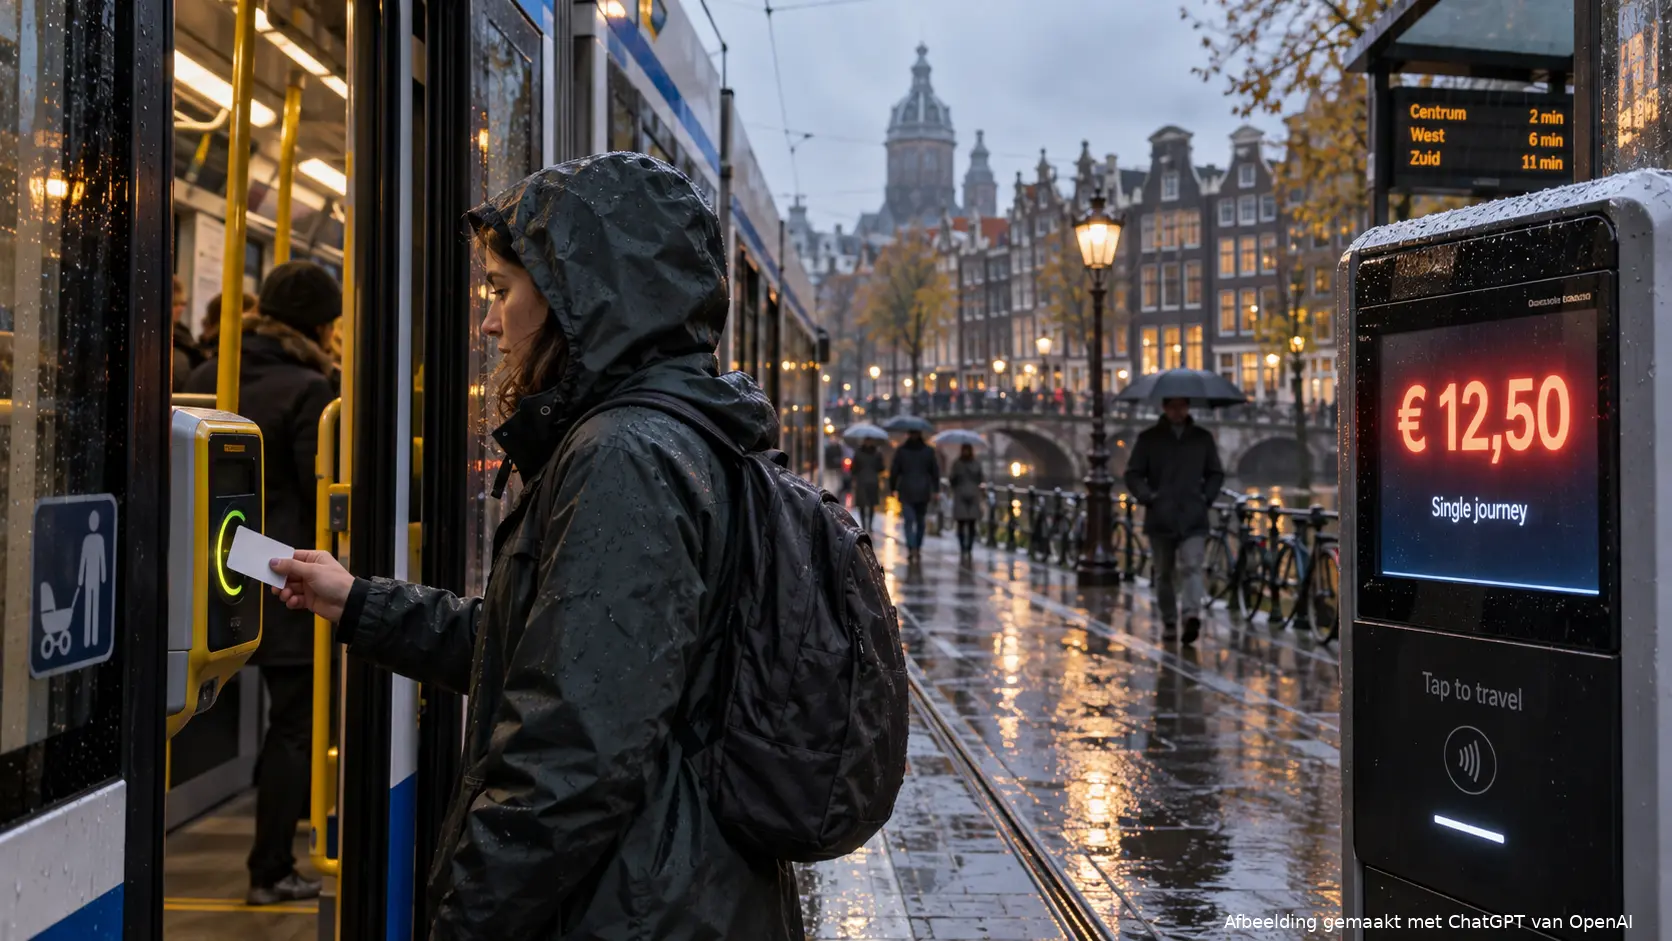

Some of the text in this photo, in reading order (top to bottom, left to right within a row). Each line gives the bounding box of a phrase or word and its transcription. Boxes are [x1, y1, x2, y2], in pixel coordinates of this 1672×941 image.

[1410, 103, 1467, 121] Centrum
[1529, 109, 1564, 125] 2 min
[1410, 127, 1445, 143] West
[1528, 132, 1563, 147] 6 min
[1410, 149, 1441, 166] Zuid
[1522, 155, 1563, 170] 11 min
[1397, 374, 1571, 464] € 12,50
[1431, 495, 1528, 527] Single journey
[1422, 671, 1523, 711] Tap to travel
